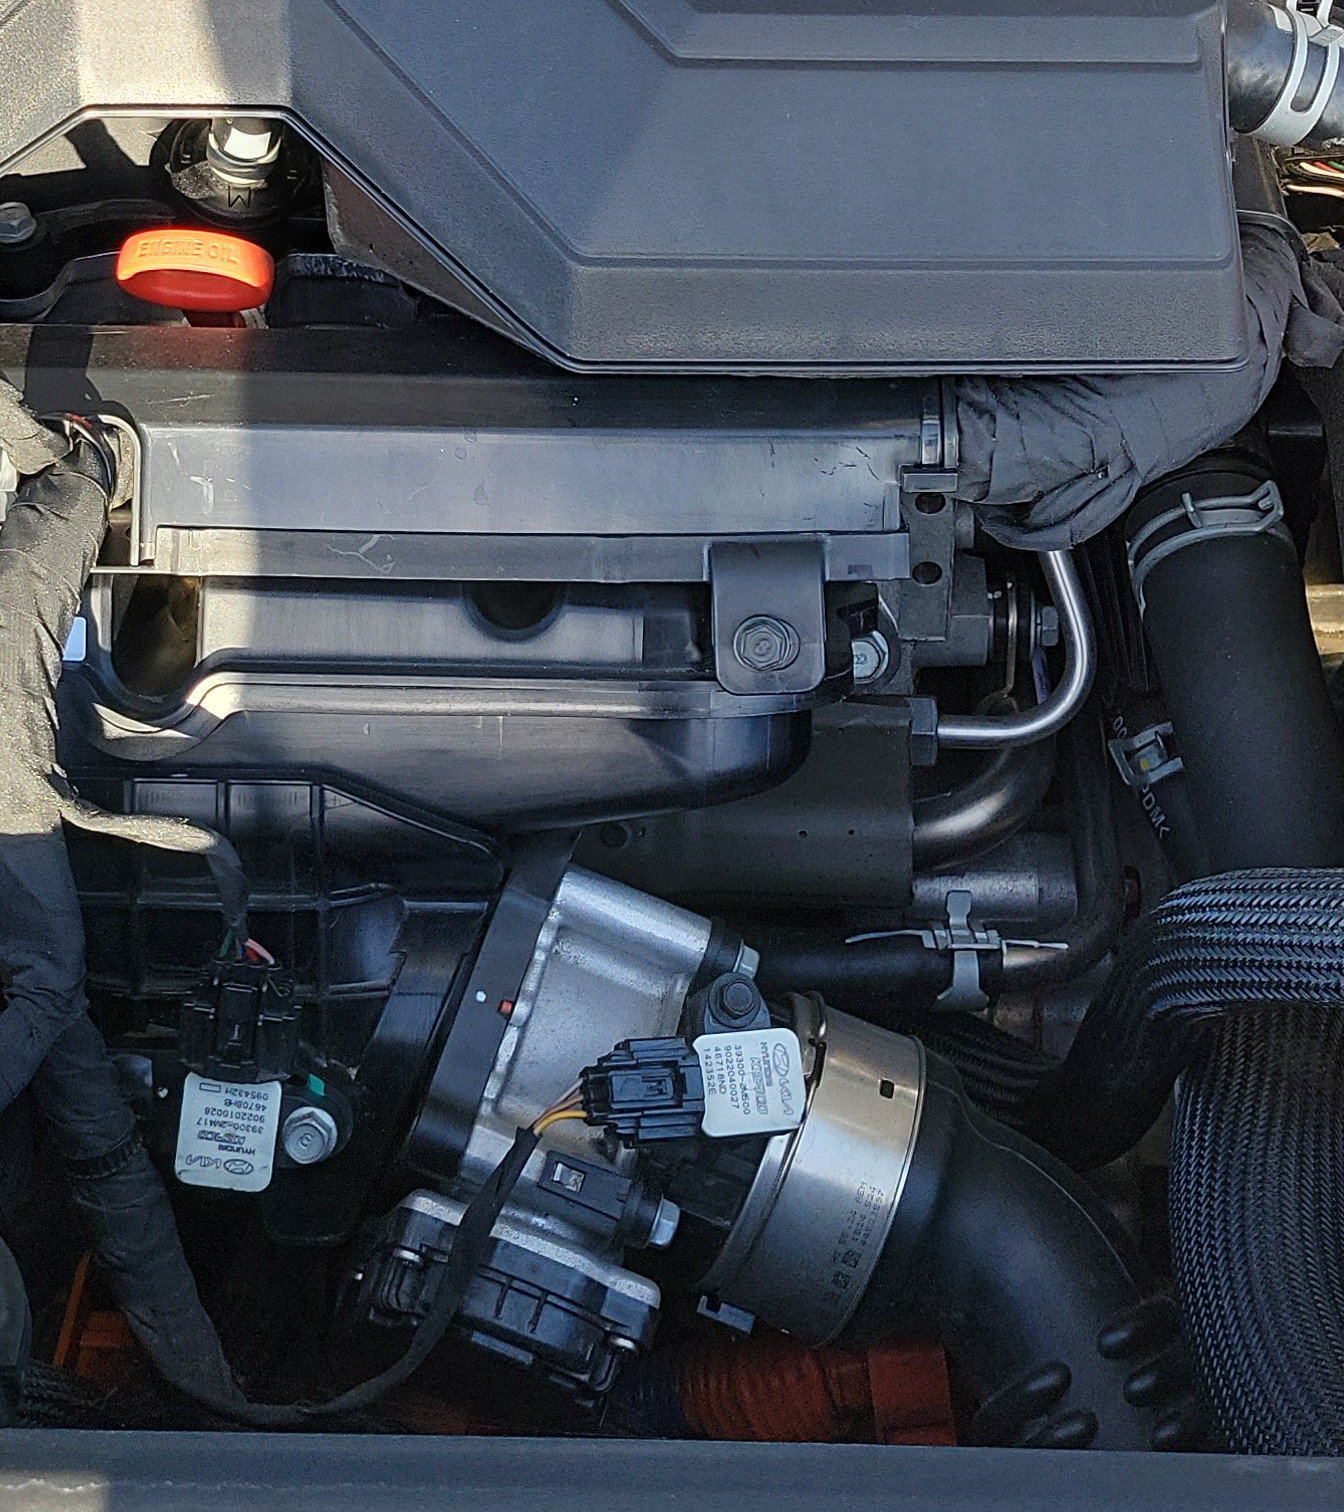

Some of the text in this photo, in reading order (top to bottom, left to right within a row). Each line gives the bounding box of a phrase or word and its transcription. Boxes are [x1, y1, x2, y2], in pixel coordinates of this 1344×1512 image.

[136, 238, 240, 265] ENGINE OIL
[703, 1047, 717, 1095] 142352E
[724, 1044, 740, 1109] 9022040027
